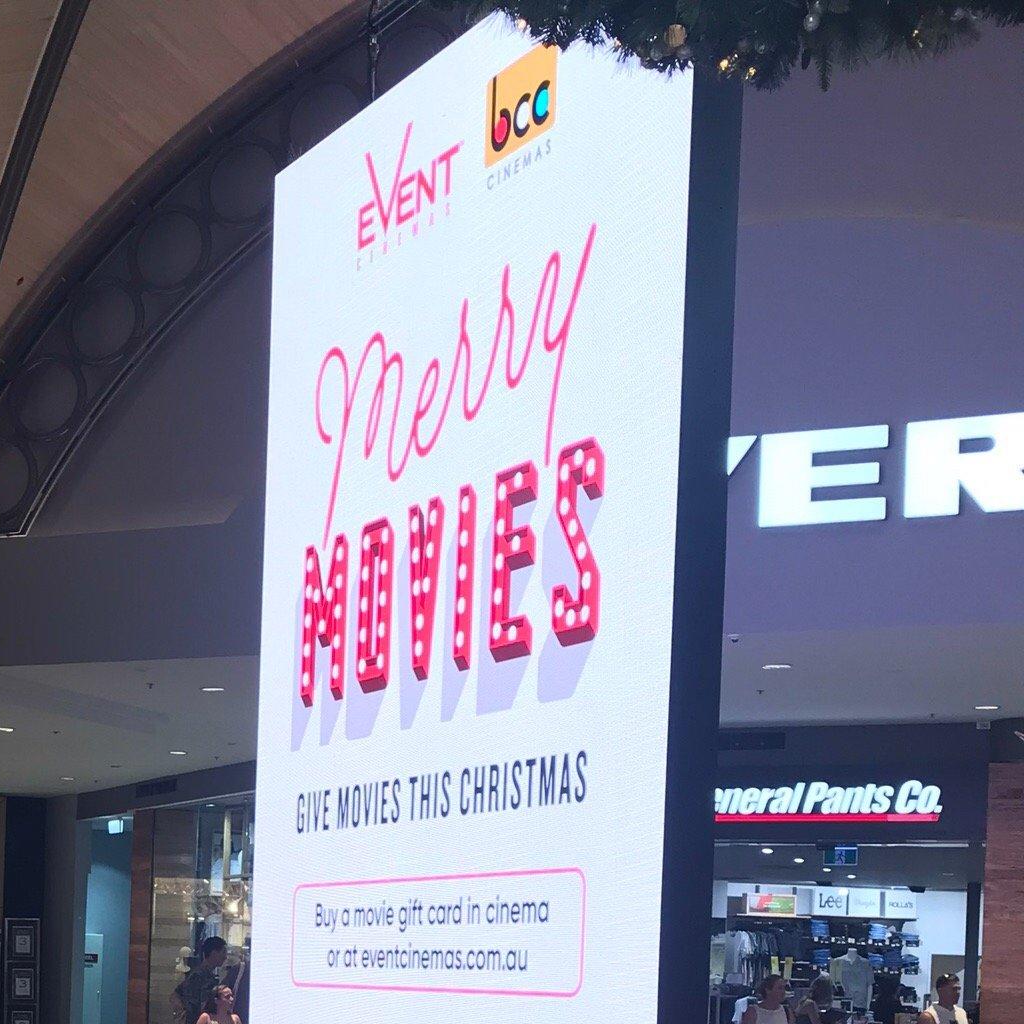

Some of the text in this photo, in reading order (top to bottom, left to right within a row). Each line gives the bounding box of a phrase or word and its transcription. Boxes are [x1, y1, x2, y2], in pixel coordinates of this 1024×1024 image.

[491, 75, 551, 152] bcc
[486, 138, 552, 192] CINEMAS
[315, 222, 597, 544] Merry
[300, 437, 606, 708] MOVIES
[297, 750, 587, 834] GIVE MOVIES THIS CHRISTMAS
[803, 781, 895, 815] Pants
[894, 779, 944, 814] Co.
[315, 894, 550, 932] Buy a movie gift card in cinema
[819, 893, 843, 908] Lee
[327, 943, 528, 971] or at eventcinemas.com.au
